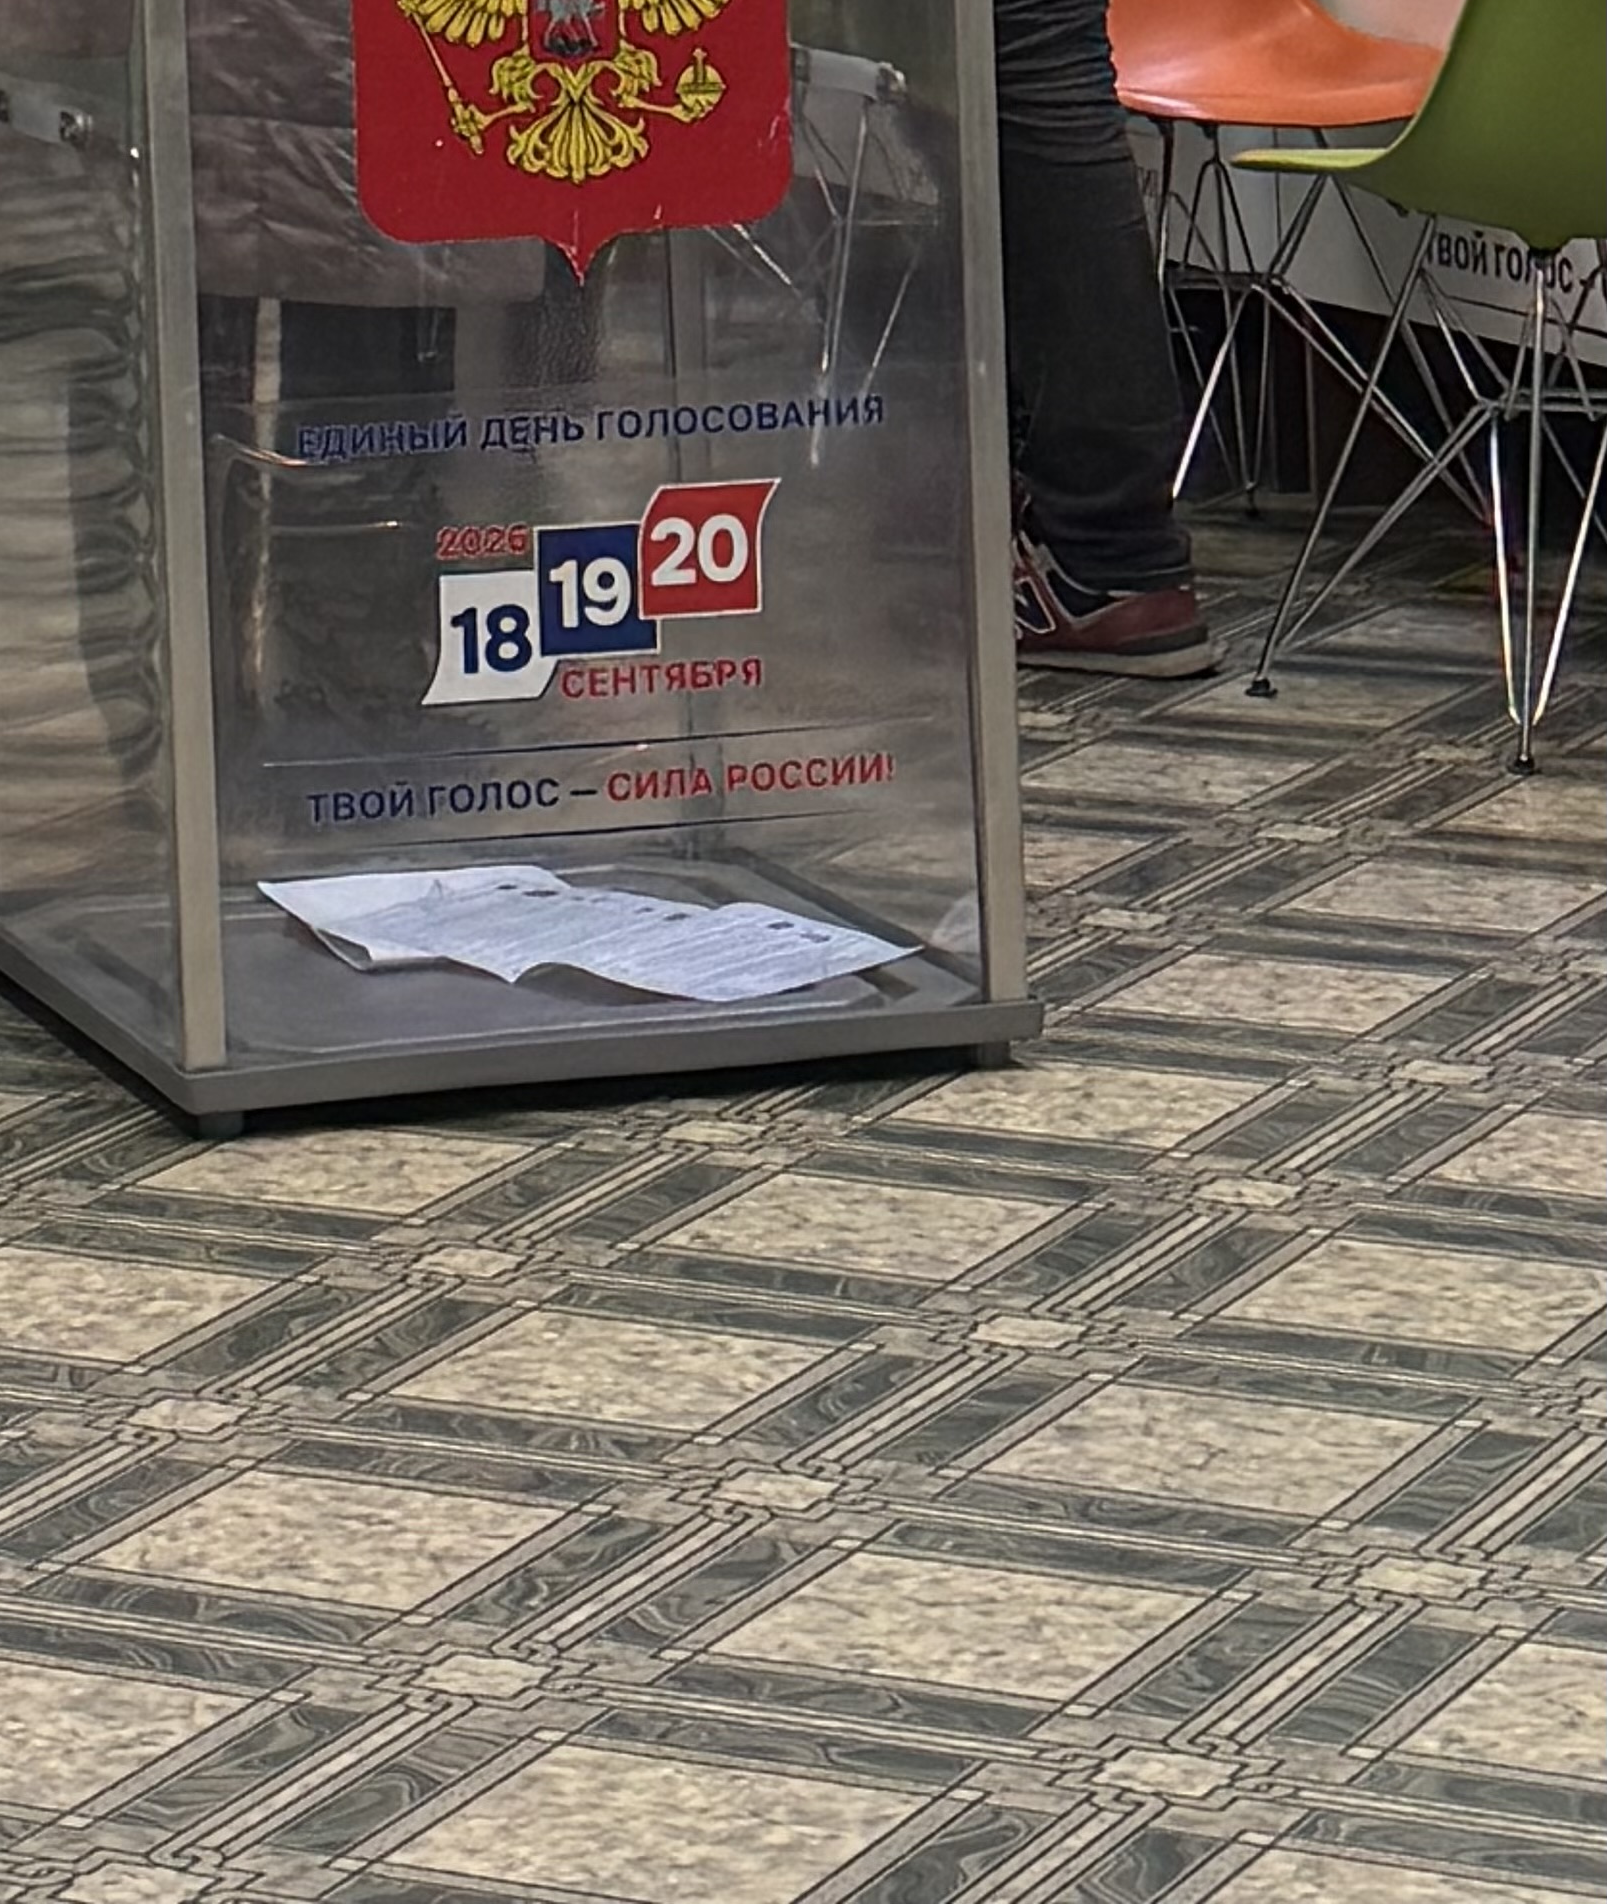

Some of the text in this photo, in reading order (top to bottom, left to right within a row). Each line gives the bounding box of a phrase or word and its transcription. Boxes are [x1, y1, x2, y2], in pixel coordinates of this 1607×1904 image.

[298, 394, 885, 460] ЕДИНЫЙ ДЕНЬ ГОЛОСОВАНИЯ
[437, 524, 529, 560] 2026
[450, 513, 750, 675] 18 19 20
[560, 656, 763, 699] СЕНТЯБРЯ
[308, 780, 415, 824] ТВОЙ
[426, 777, 560, 818] ГОЛОС
[606, 767, 714, 803] СИЛА
[725, 752, 895, 790] РОССИИ!
